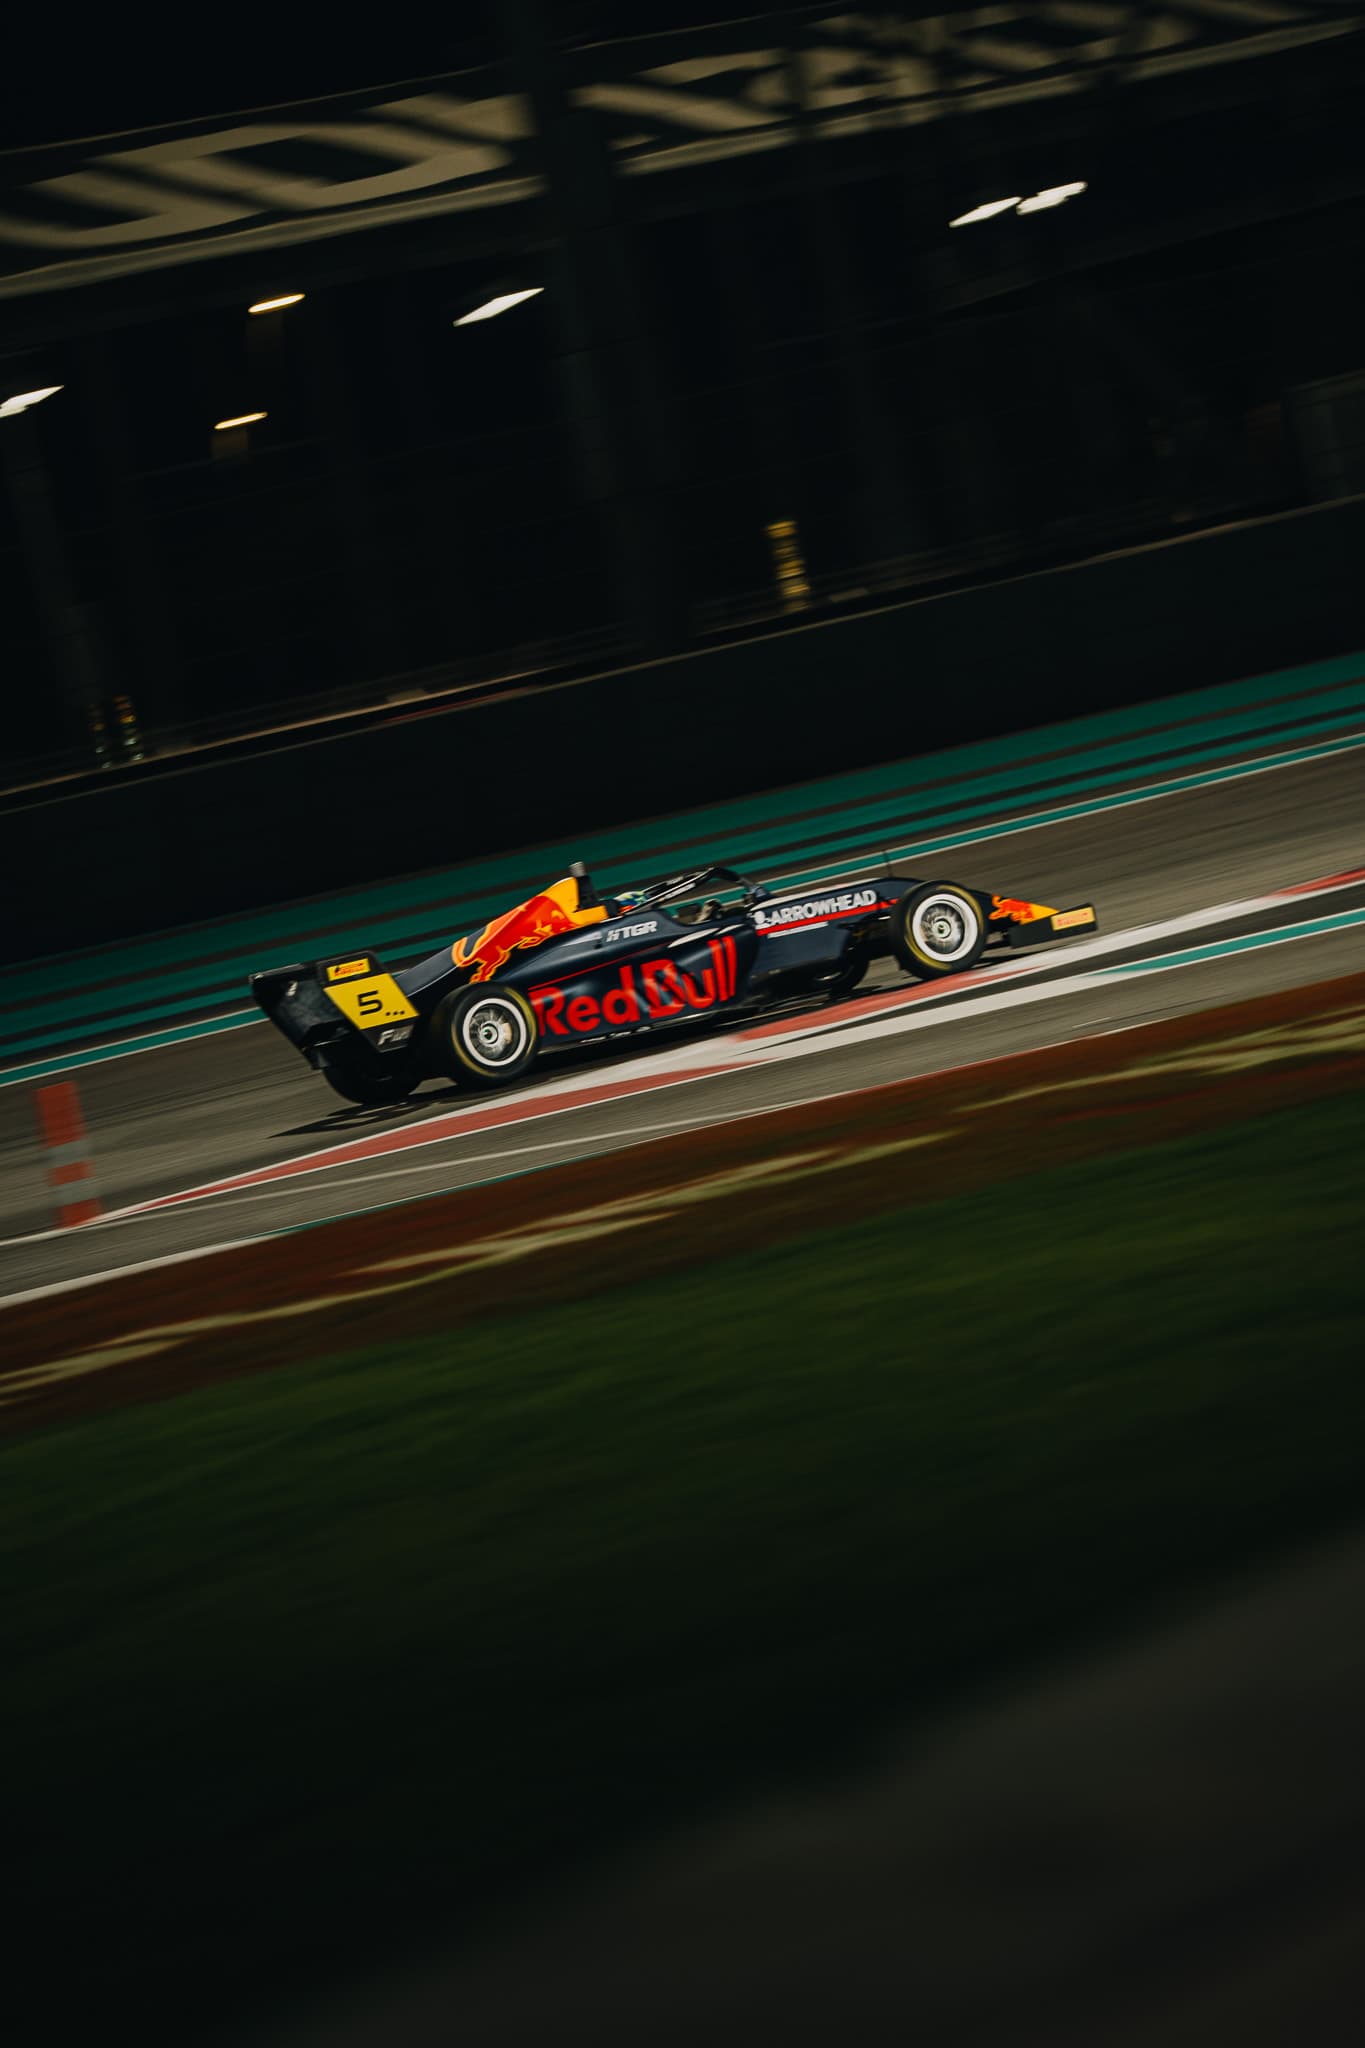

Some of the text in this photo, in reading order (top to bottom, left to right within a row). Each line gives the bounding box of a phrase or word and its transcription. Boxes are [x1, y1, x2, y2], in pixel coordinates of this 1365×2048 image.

[770, 890, 877, 925] ARROWHEAD
[528, 935, 737, 1036] Red Bull
